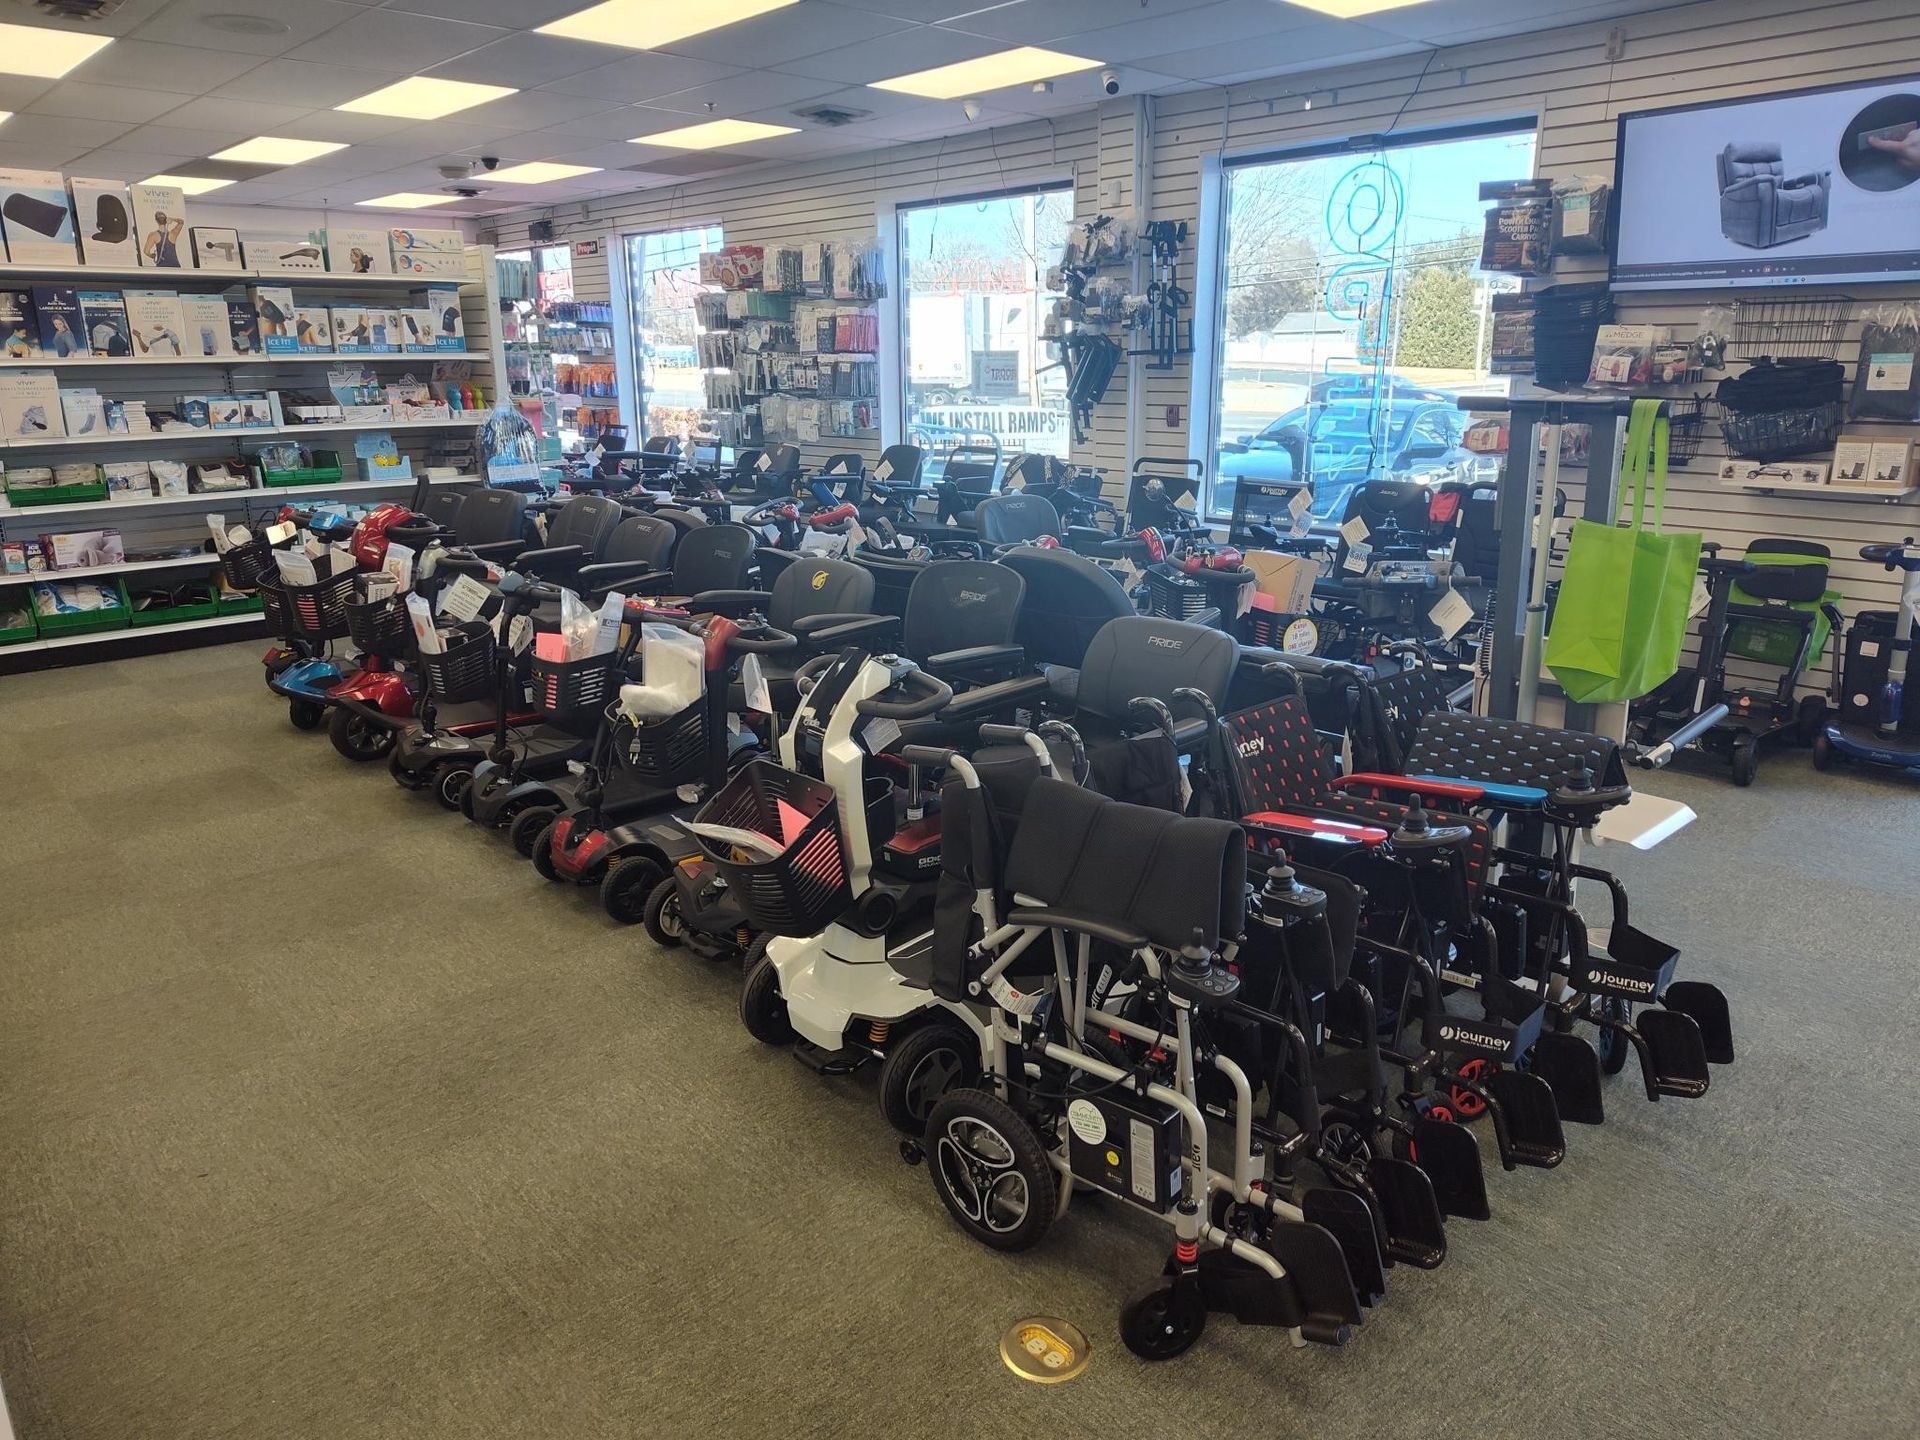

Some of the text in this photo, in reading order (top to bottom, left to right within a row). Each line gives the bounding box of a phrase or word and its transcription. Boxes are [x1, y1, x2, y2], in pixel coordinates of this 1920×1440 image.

[949, 411, 1005, 433] INSTALL
[1008, 411, 1057, 434] RAMPS
[960, 590, 988, 603] PRIDE
[1147, 635, 1183, 651] PRIDE
[1600, 970, 1656, 993] journey
[1454, 1026, 1512, 1052] journey
